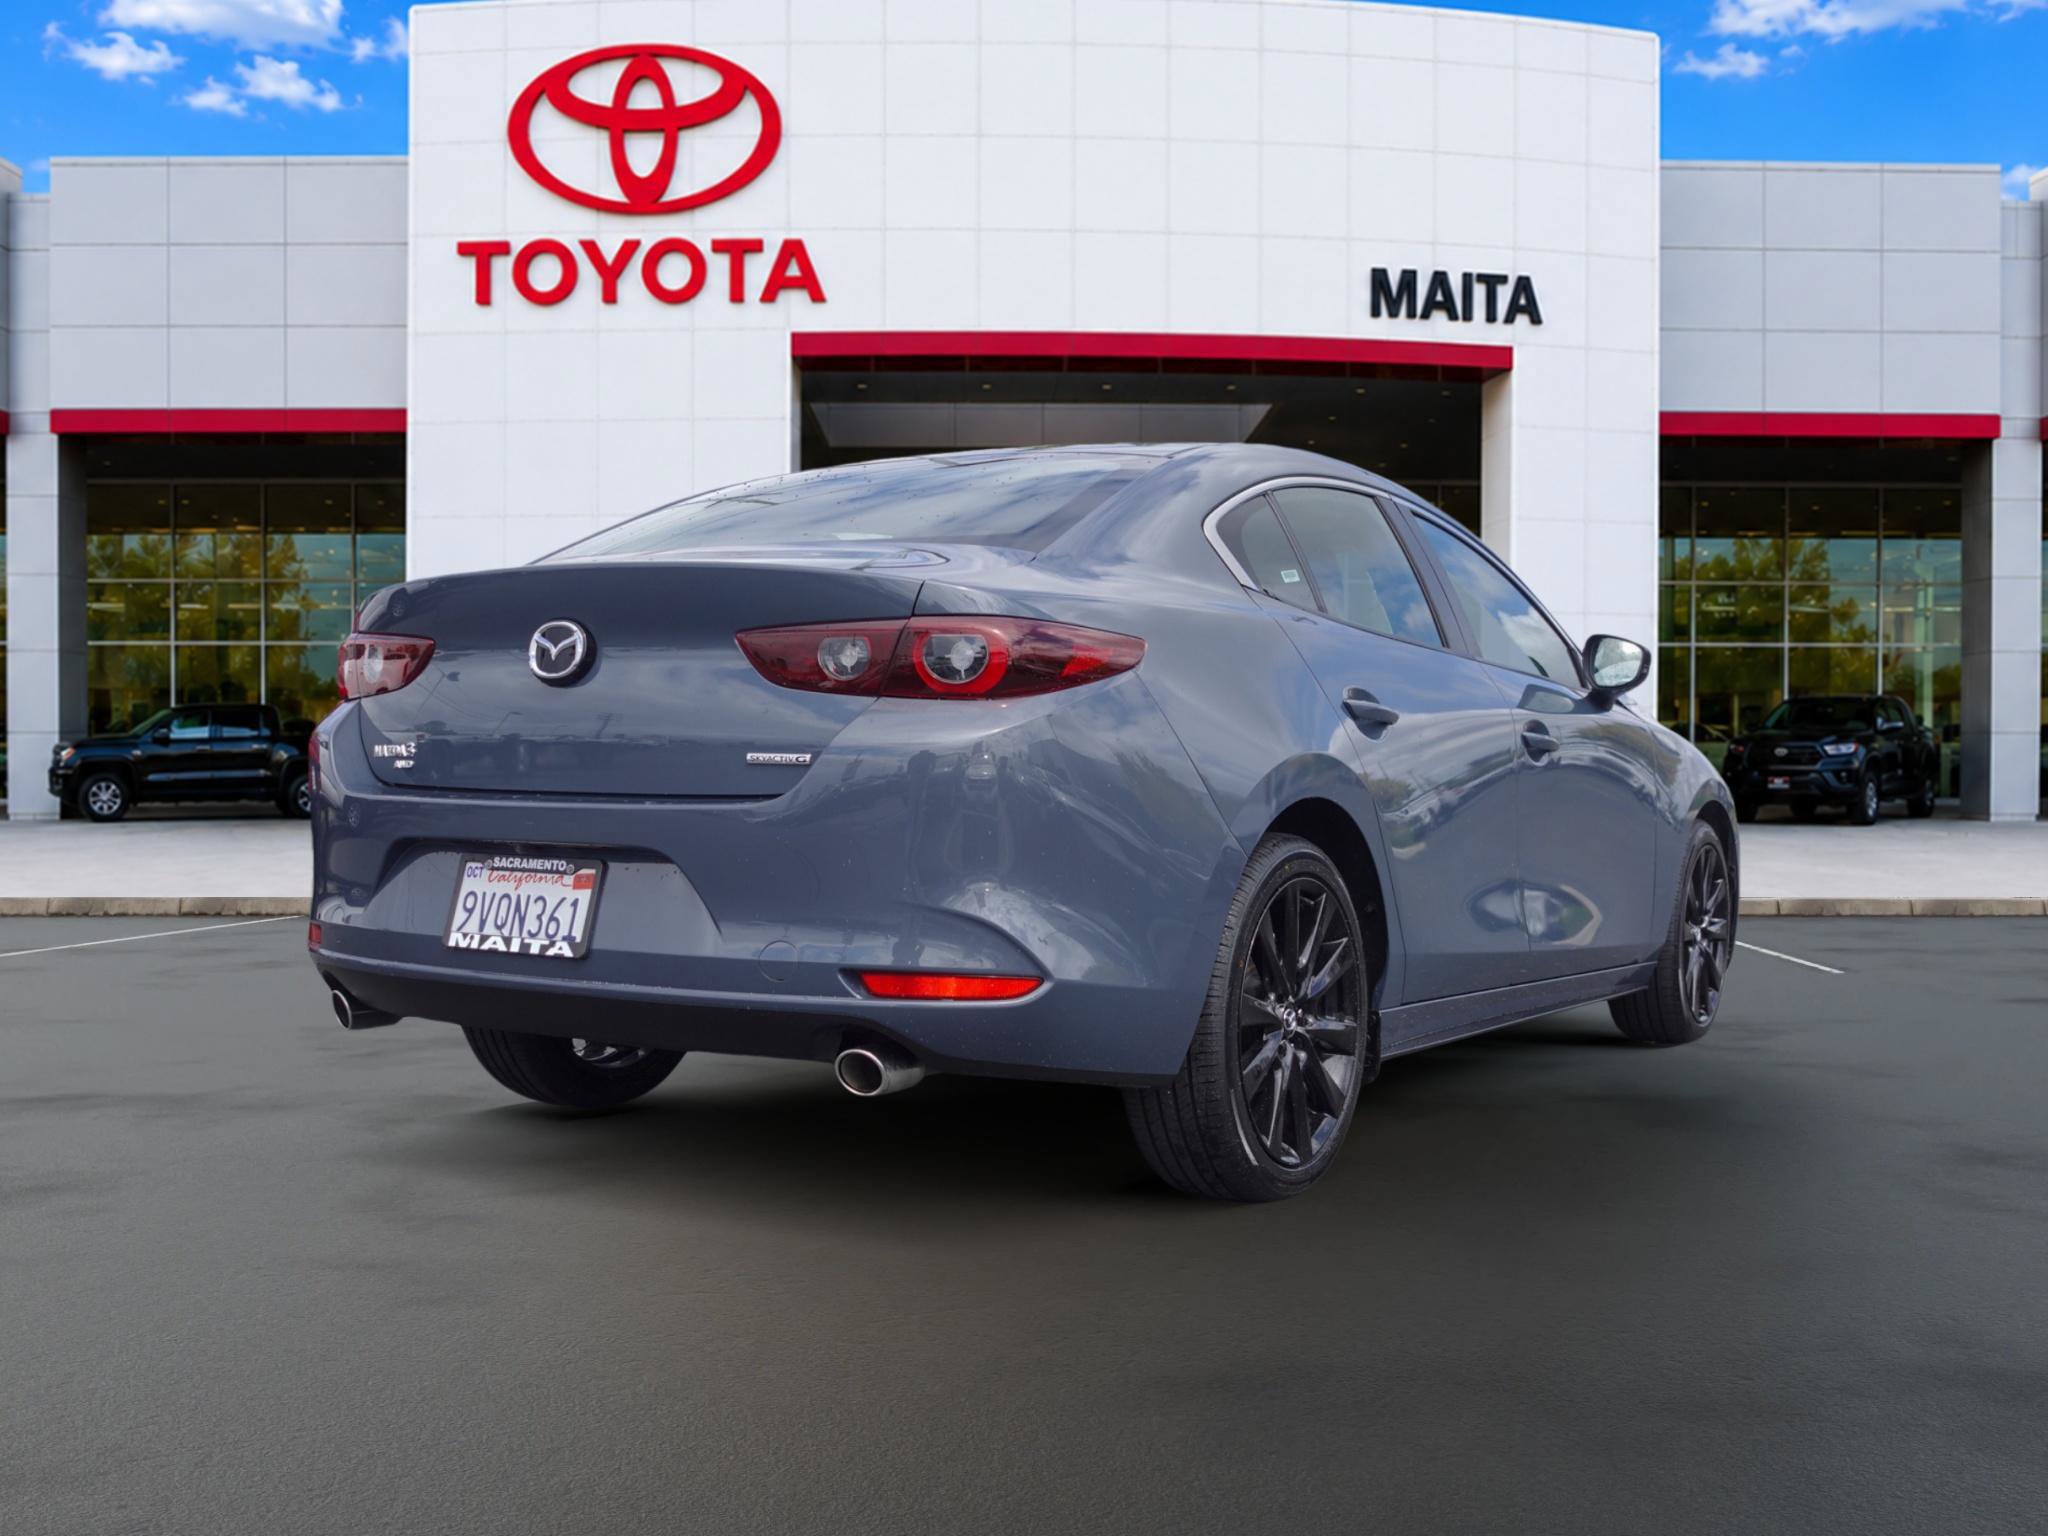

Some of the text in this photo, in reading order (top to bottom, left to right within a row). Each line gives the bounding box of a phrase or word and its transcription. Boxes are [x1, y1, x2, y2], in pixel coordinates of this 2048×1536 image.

[457, 237, 827, 306] TOYOTA
[1370, 267, 1543, 326] MAITA
[466, 866, 483, 879] OCT
[493, 856, 567, 872] SACRAMENTO
[487, 869, 573, 891] California
[456, 890, 580, 942] 9VQN361
[447, 932, 574, 959] MAITA
